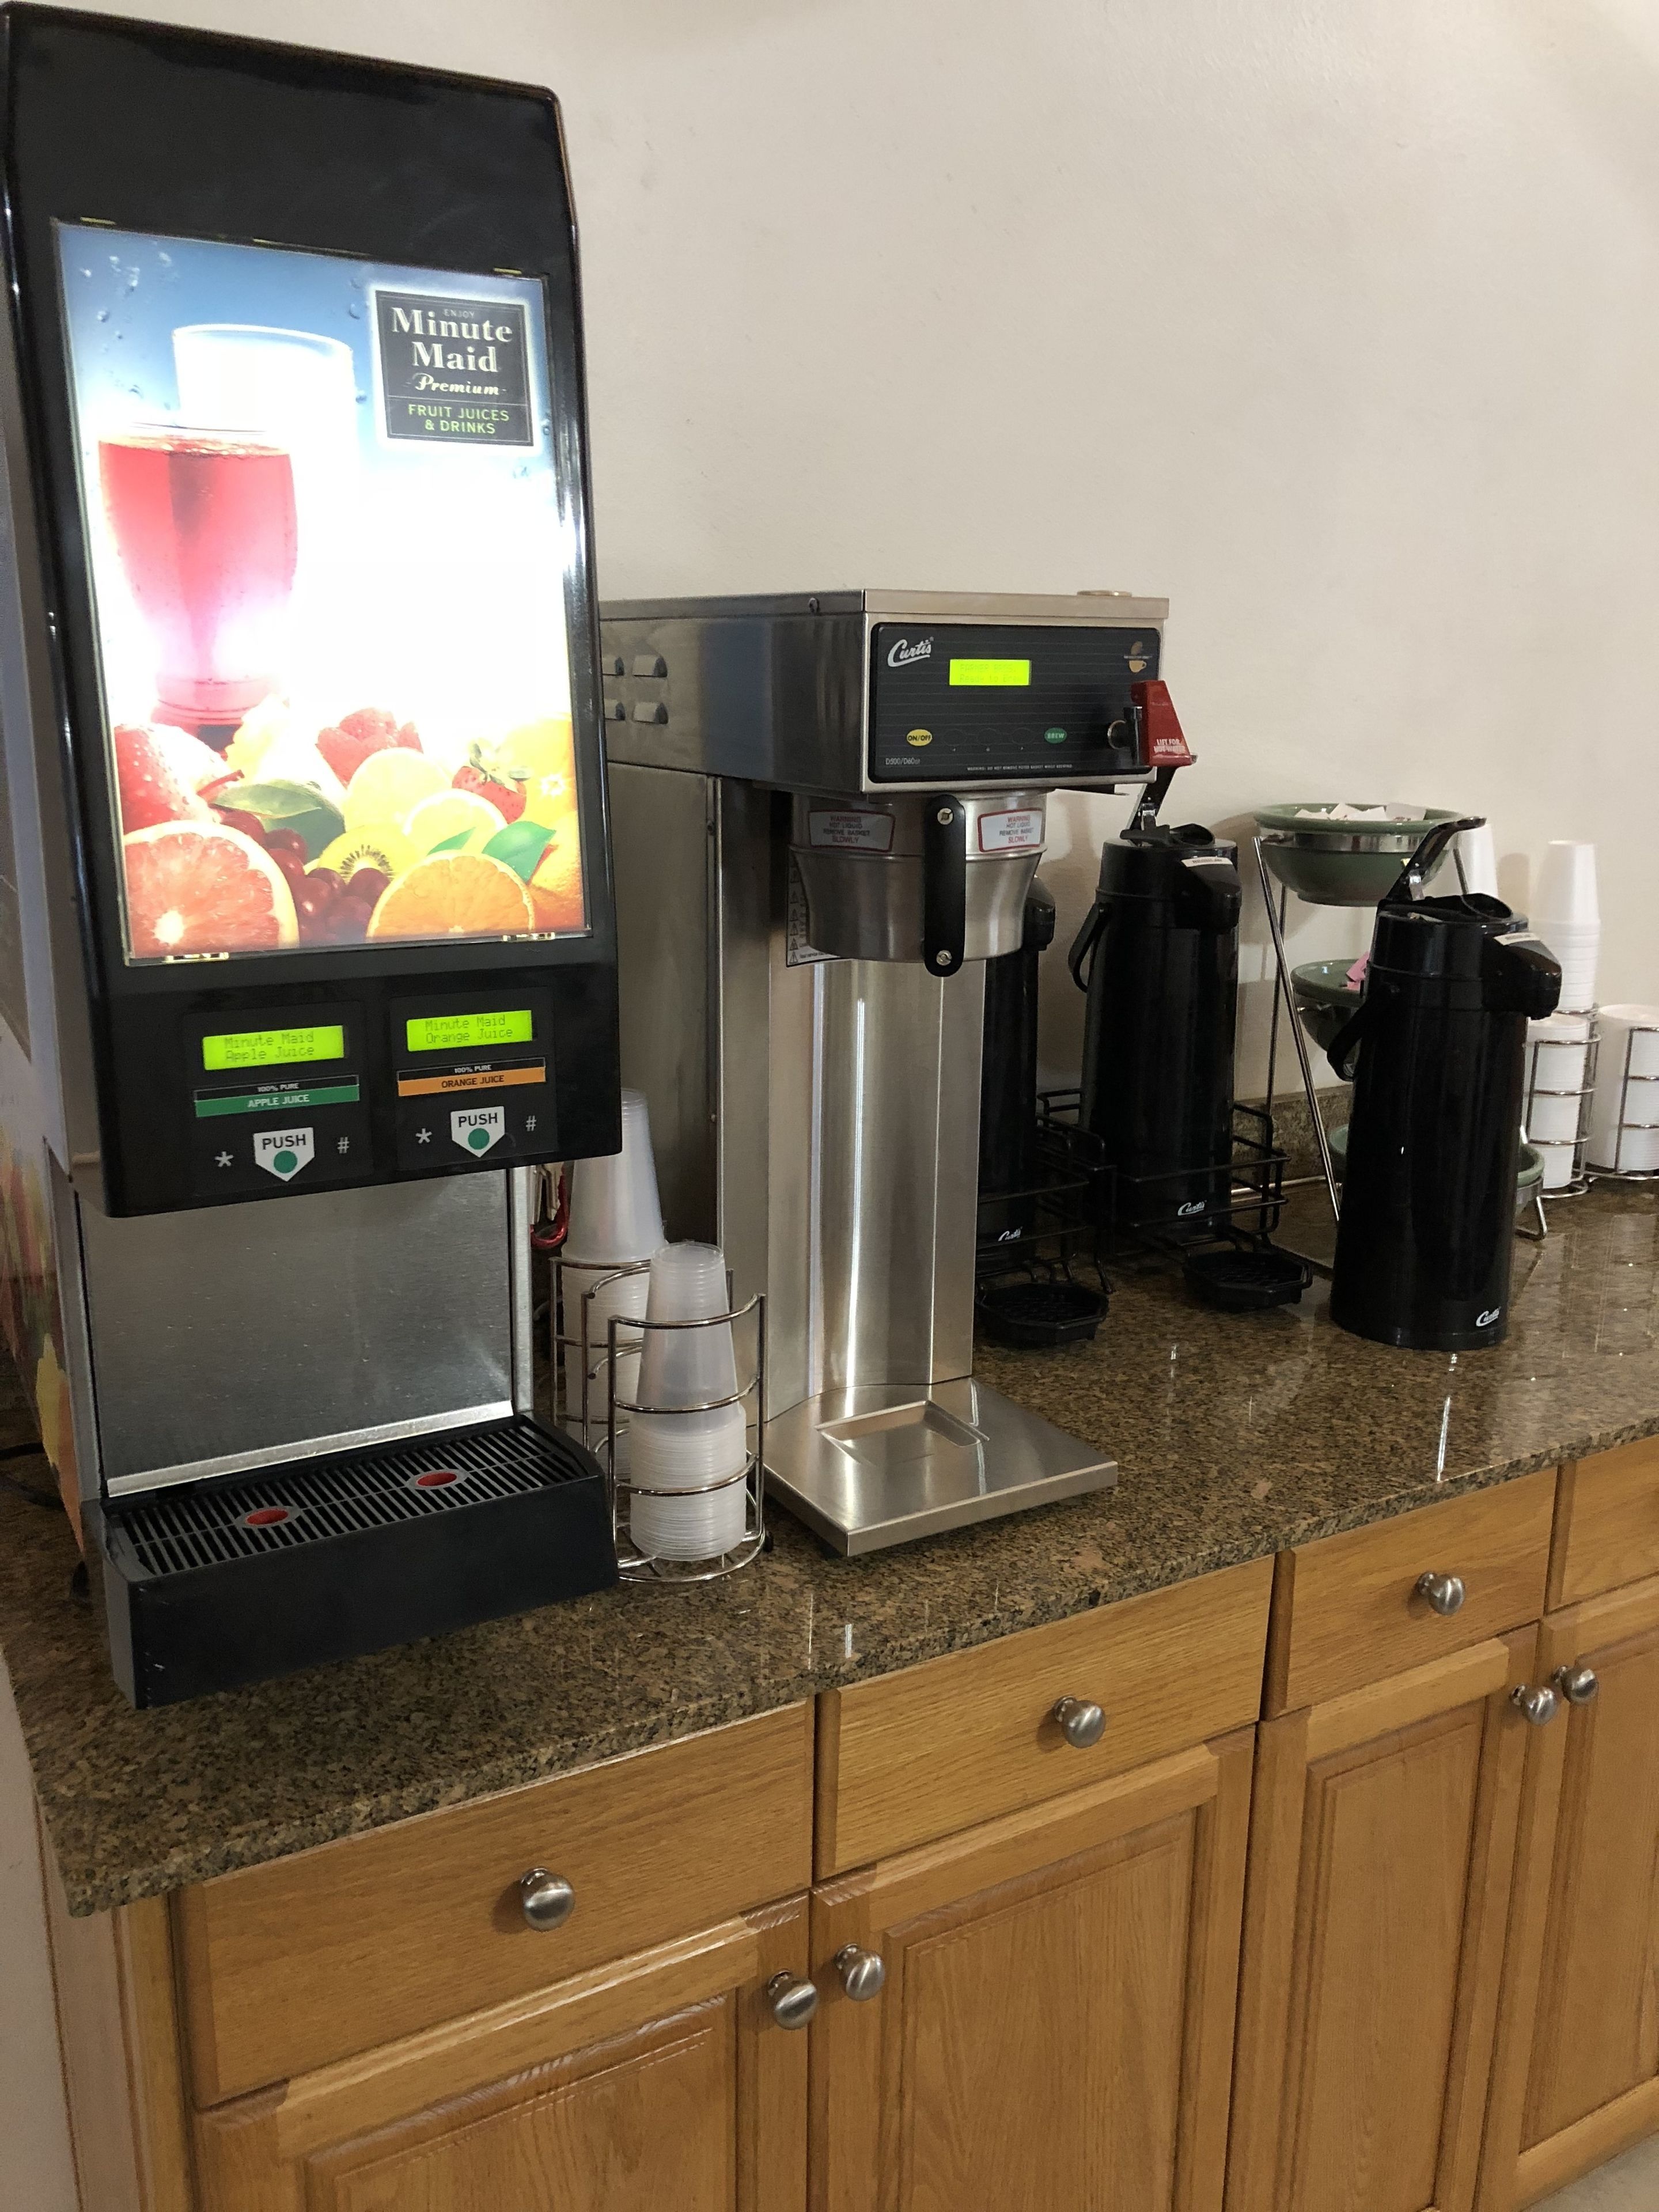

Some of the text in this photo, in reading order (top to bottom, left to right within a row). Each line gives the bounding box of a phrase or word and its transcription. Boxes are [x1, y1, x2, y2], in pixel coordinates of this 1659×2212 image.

[444, 309, 475, 318] ENJOY
[392, 307, 513, 342] Minute
[411, 341, 499, 373] Maid
[412, 373, 499, 395] Premium
[408, 404, 510, 422] FRUIT JUICES
[425, 419, 495, 434] & DRINKS
[887, 638, 931, 667] Curtis
[1007, 815, 1031, 823] WARNING
[832, 835, 859, 843] SLOWLY
[1007, 835, 1028, 843] SLOWLY
[425, 1015, 505, 1032] Minute Maid
[223, 1031, 315, 1050] Minute Maid
[426, 1028, 513, 1044] Orange Juice
[226, 1046, 315, 1062] Apple Juice
[257, 1082, 300, 1093] 100% PURE
[441, 1075, 505, 1088] ORANGE JUICE
[247, 1094, 310, 1108] APPLE JUICE
[458, 1112, 498, 1128] PUSH
[262, 1134, 306, 1150] PUSH
[1177, 1202, 1205, 1216] Curtis
